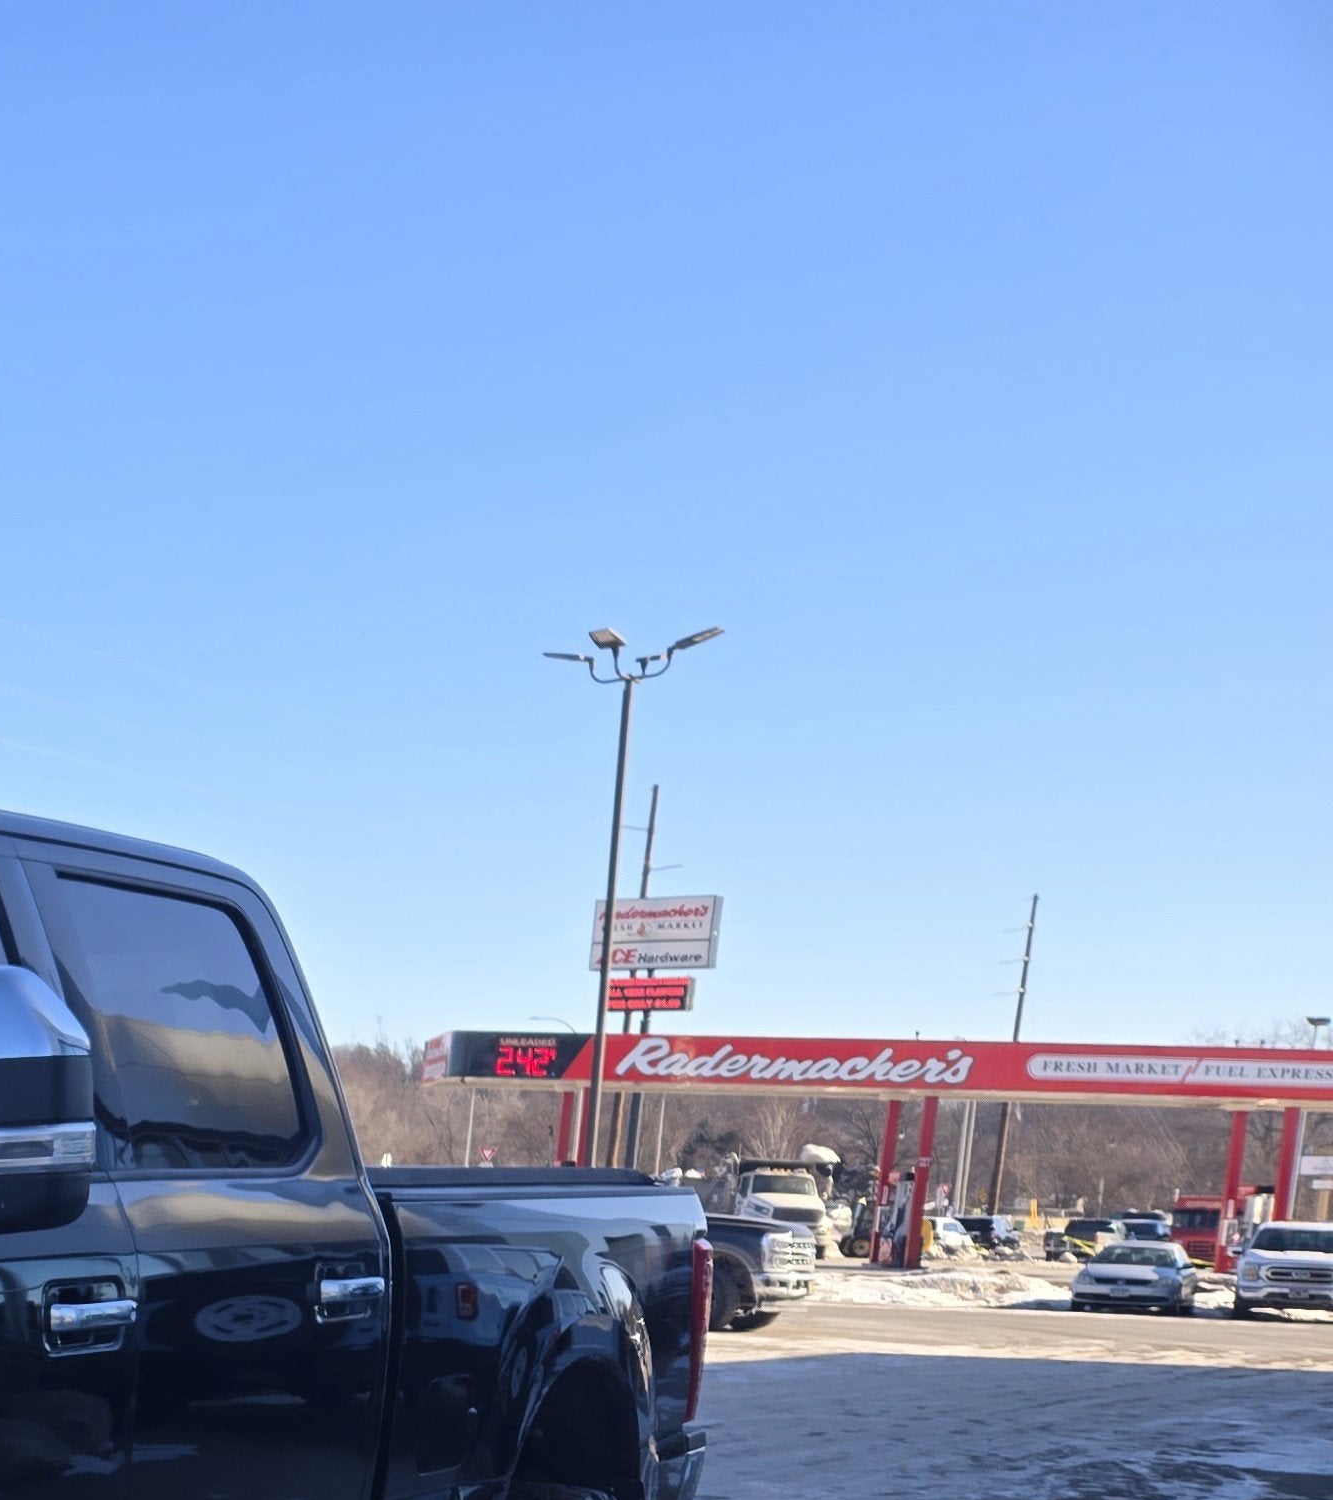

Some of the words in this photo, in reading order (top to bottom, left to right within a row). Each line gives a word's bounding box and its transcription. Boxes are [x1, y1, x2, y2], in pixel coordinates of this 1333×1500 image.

[637, 951, 703, 964] Hardware
[616, 1037, 974, 1084] Radermacher's
[1042, 1060, 1098, 1074] FRESH
[1106, 1061, 1183, 1076] MARKET
[1203, 1064, 1249, 1078] FUEL
[1256, 1066, 1333, 1081] EXPRESS
